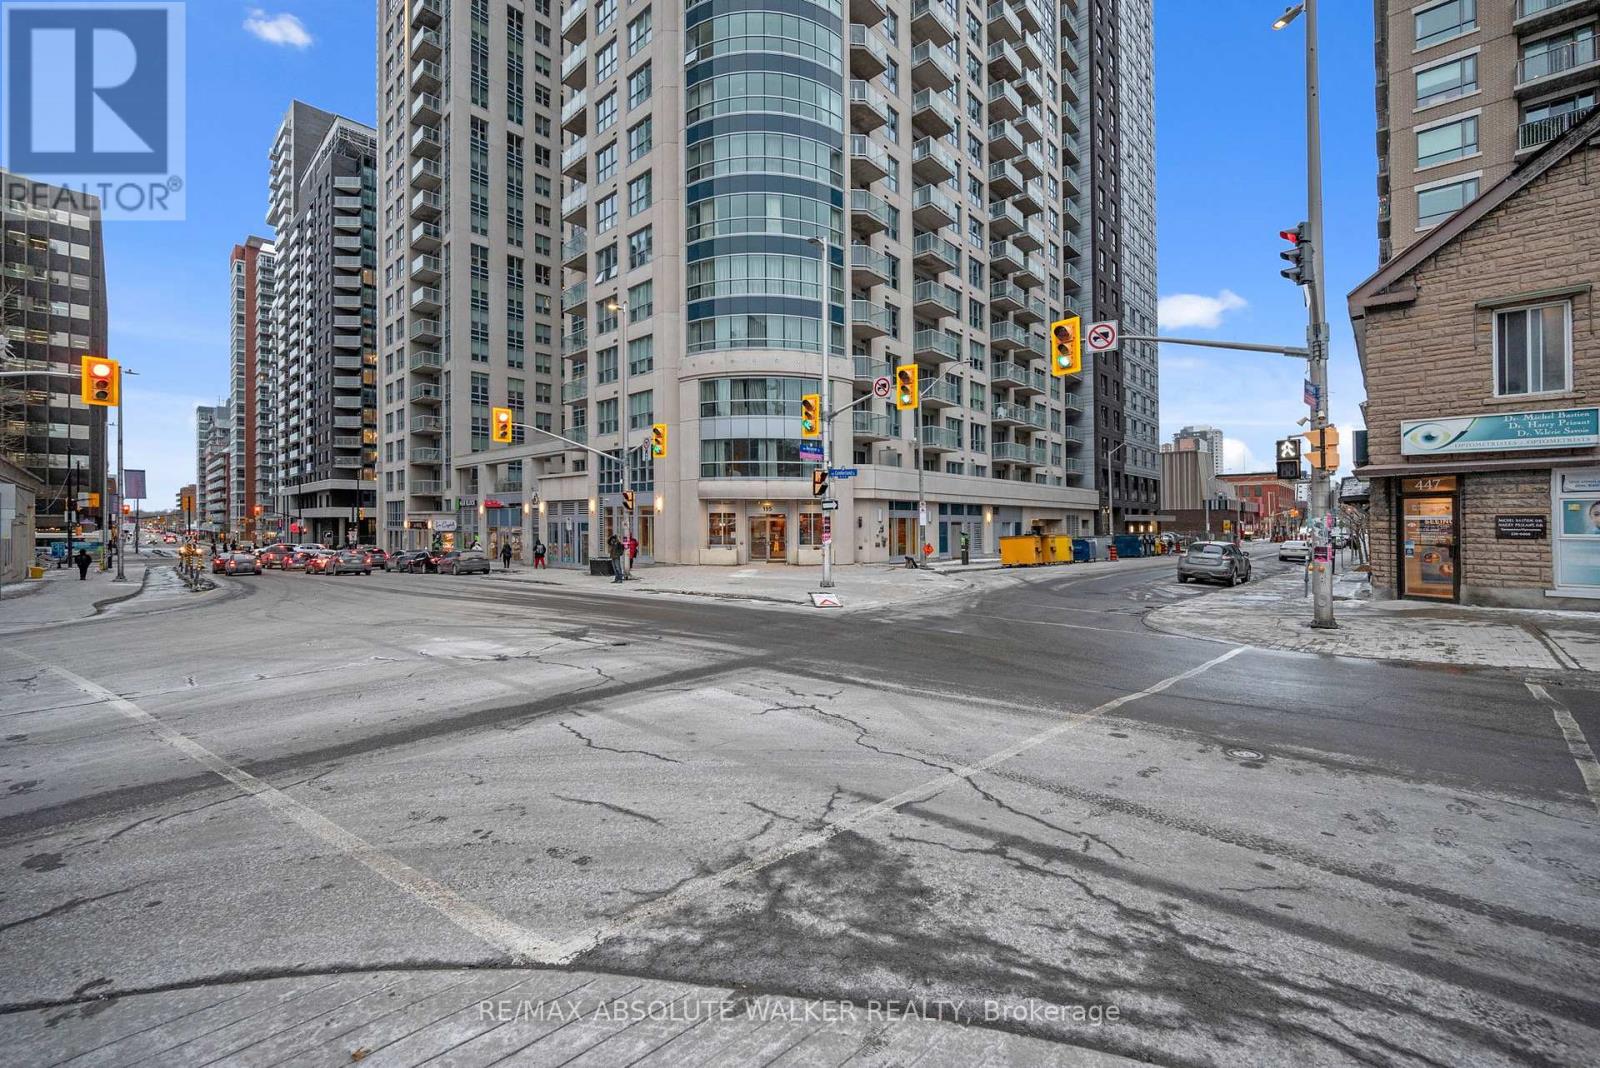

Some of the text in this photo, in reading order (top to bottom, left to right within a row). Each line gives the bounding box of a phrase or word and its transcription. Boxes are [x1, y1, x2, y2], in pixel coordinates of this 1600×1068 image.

[1523, 413, 1554, 421] Michel
[1558, 411, 1590, 419] Bastien
[1528, 421, 1555, 429] Harry
[1564, 427, 1590, 435] Savoie
[1414, 479, 1441, 491] 447
